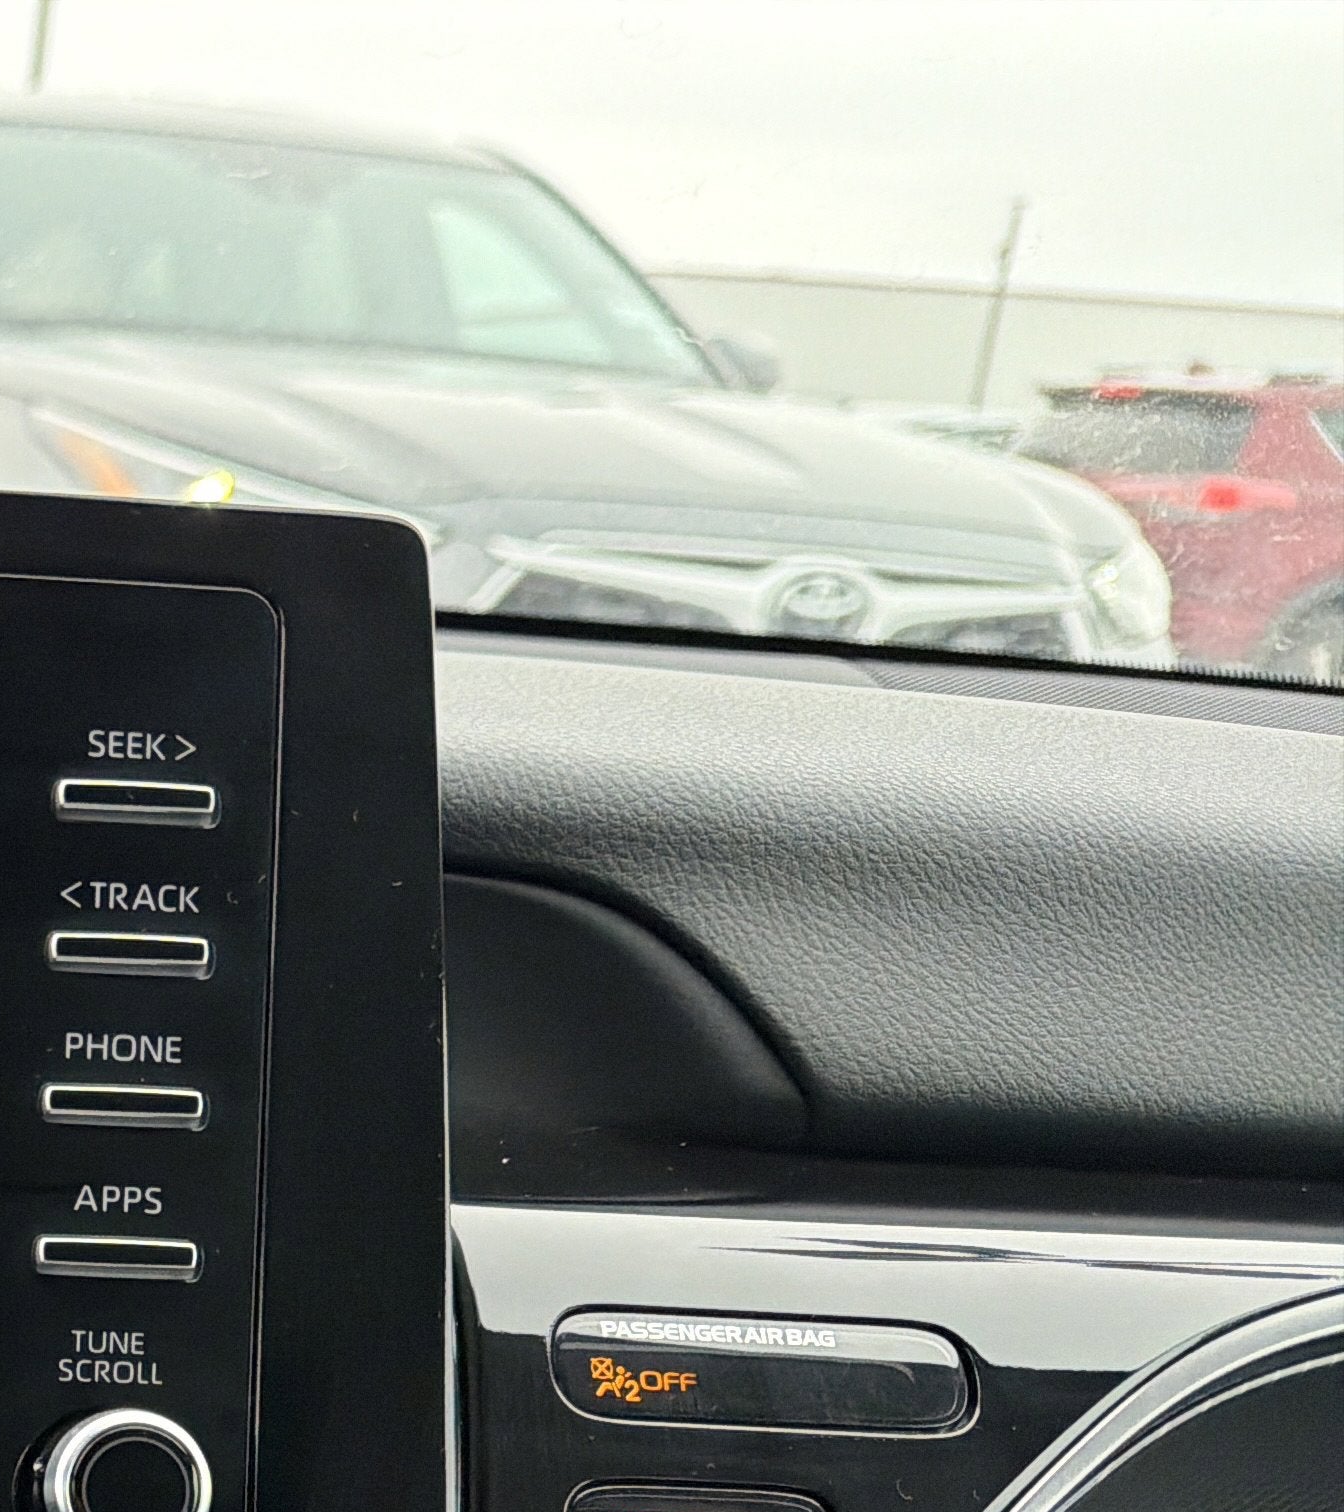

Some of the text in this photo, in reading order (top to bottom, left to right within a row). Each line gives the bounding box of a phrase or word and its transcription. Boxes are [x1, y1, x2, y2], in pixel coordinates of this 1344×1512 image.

[87, 729, 167, 761] SEEK
[90, 881, 200, 913] TRACK
[64, 1032, 182, 1064] PHONE
[73, 1184, 163, 1215] APPS
[71, 1330, 145, 1355] TUNE
[600, 1320, 743, 1344] PASSENGER
[786, 1329, 836, 1348] BAG
[58, 1359, 163, 1385] SCROLL
[640, 1371, 698, 1393] OFF
